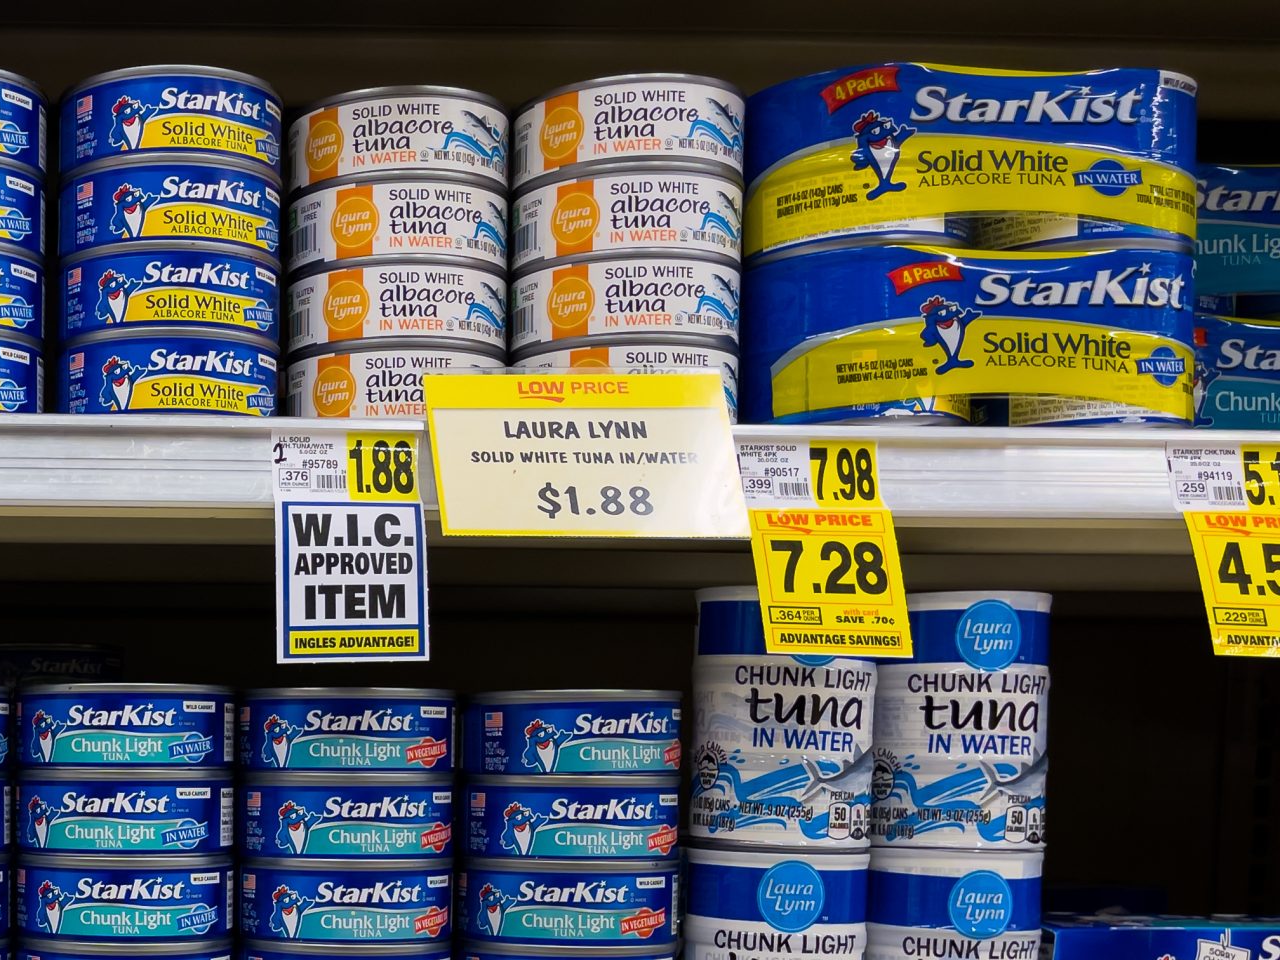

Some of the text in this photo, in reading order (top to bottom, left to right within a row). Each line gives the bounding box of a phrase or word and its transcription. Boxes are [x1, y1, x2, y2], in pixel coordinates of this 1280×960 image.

[834, 71, 886, 101] 4 Pack
[353, 103, 440, 119] SOLID WHITE
[910, 85, 1141, 124] StarKist
[352, 118, 453, 137] albacore
[352, 134, 410, 153] tuna
[352, 151, 416, 166] IN WATER
[916, 150, 1068, 173] Solid White
[918, 173, 1066, 187] ALBACORE TUNA
[336, 209, 370, 227] Laura
[342, 220, 373, 237] Lynn
[517, 380, 630, 395] LOW PRICE
[504, 420, 648, 440] LAURA LYNN
[302, 459, 338, 470] #95789
[471, 451, 615, 464] SOLID WHITE TUNA
[282, 471, 308, 482] .376
[349, 440, 414, 495] 1.88
[764, 467, 799, 477] #90517
[810, 447, 875, 501] 7.98
[1198, 471, 1232, 480] #94119
[1180, 483, 1205, 493] .259
[537, 483, 654, 519] $1.88
[293, 512, 414, 547] W.I.C.
[294, 552, 412, 576] APPROVED
[771, 540, 888, 594] 7.28
[305, 583, 406, 620] ITEM
[776, 610, 801, 620] .364
[1222, 612, 1247, 622] .229
[294, 636, 414, 649] INGLES ADVANTAGE!
[67, 704, 177, 727] StarKist
[72, 738, 162, 757] Chunk Light
[102, 752, 130, 760] TUNA
[766, 880, 814, 899] Laura
[774, 896, 815, 914] Lynn
[1209, 947, 1237, 960] SORRY
